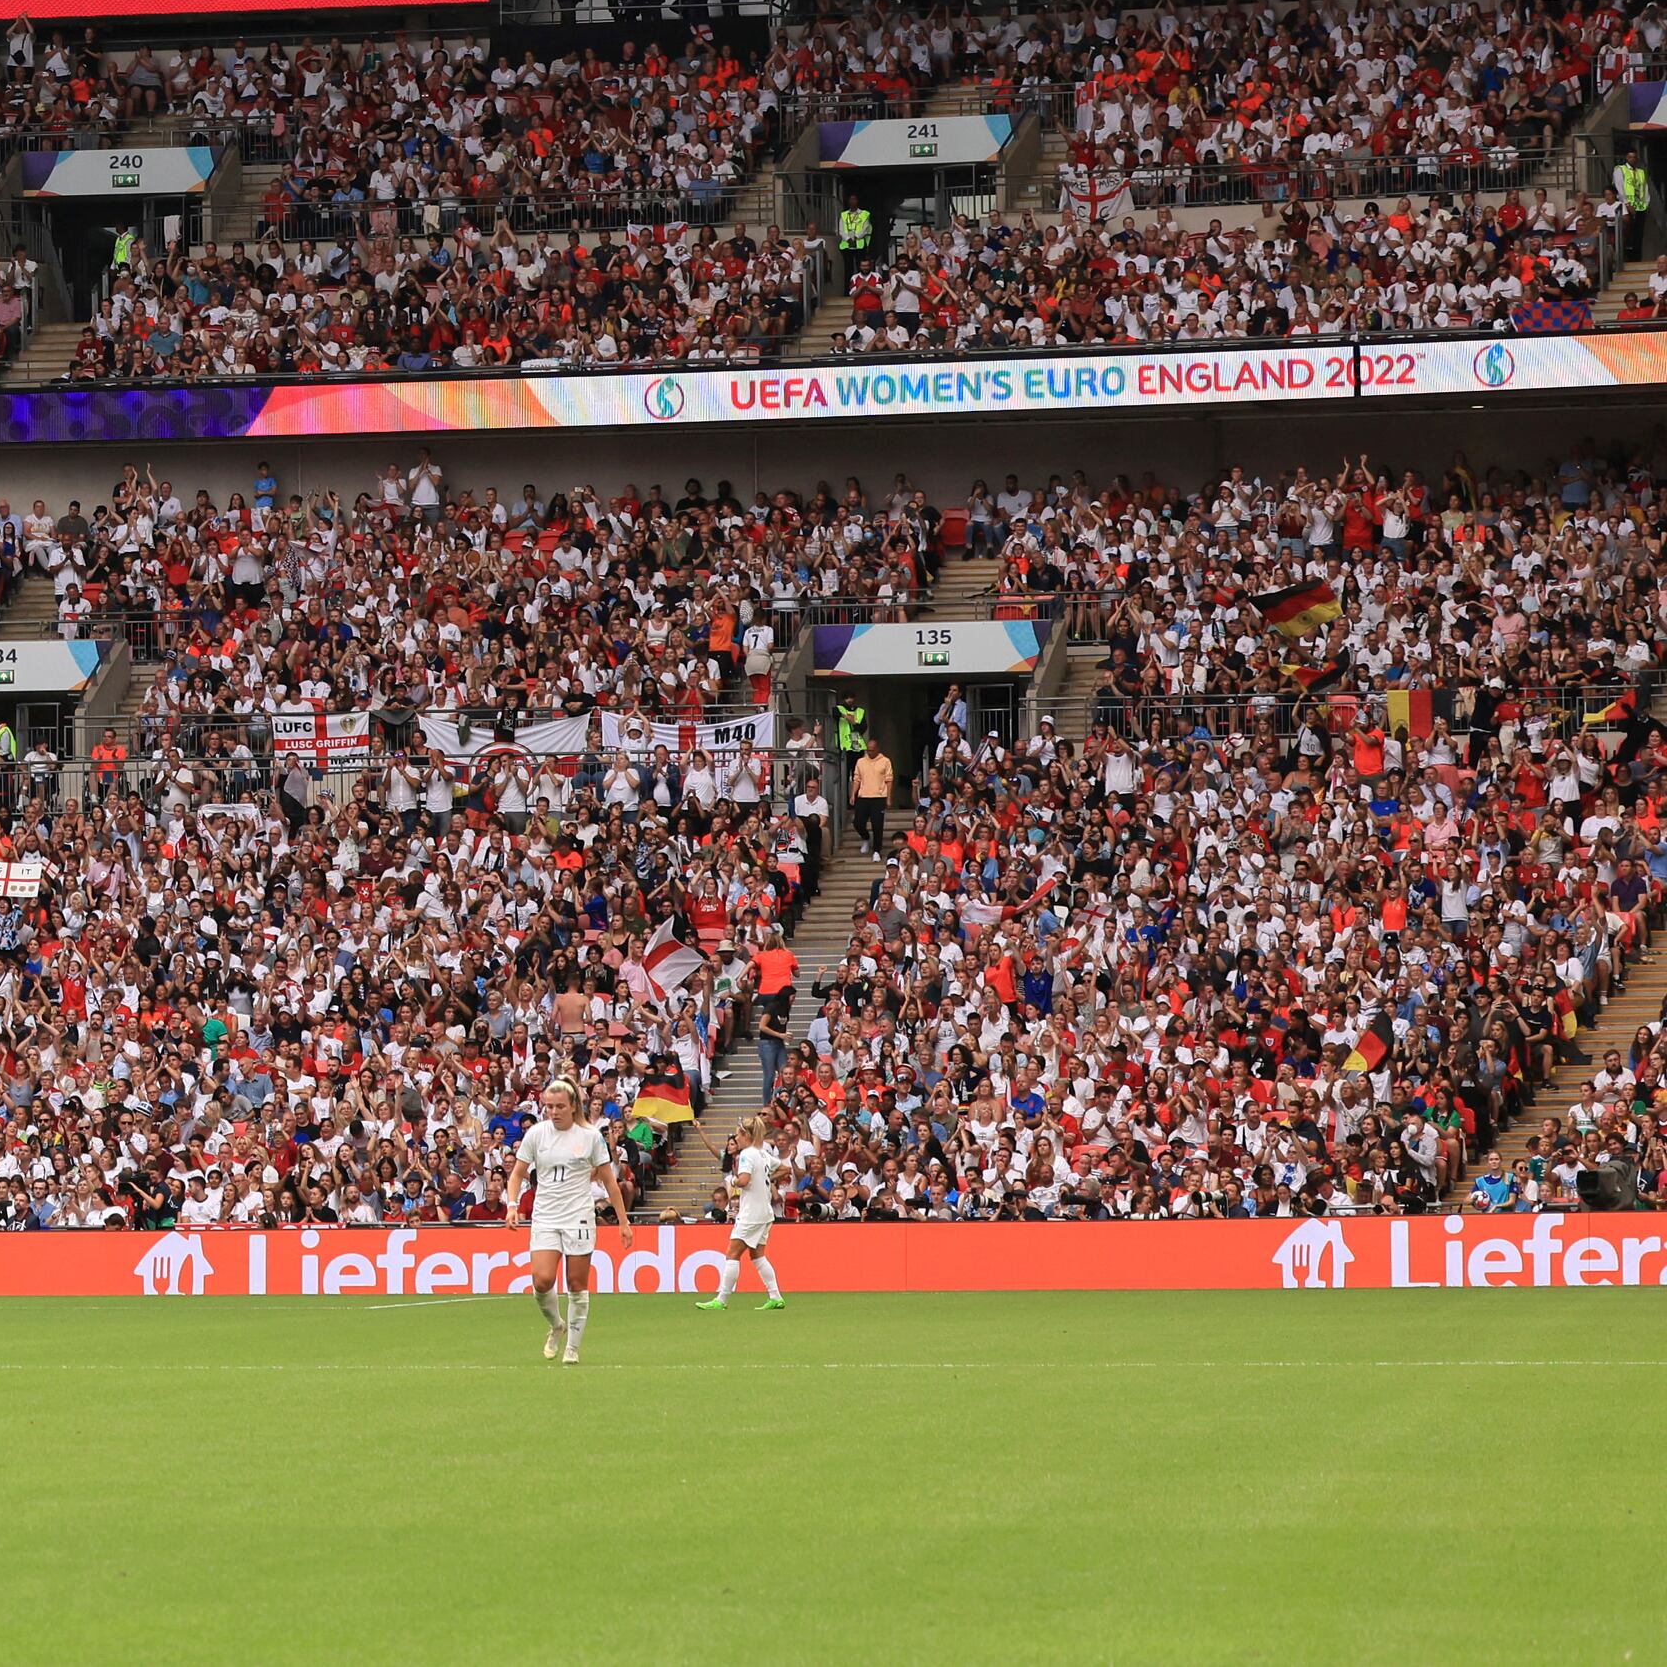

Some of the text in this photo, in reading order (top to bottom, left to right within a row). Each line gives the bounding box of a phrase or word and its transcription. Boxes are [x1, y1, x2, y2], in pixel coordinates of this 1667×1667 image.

[907, 124, 939, 138] 241
[109, 155, 143, 169] 240
[731, 377, 828, 411] UEFA
[837, 370, 1013, 408] WOMEN'S
[1024, 366, 1127, 402] EURO
[1138, 358, 1315, 395] ENGLAND
[752, 634, 759, 649] 7
[916, 629, 952, 645] 135
[274, 721, 313, 733] LUFC
[714, 723, 756, 746] M40
[285, 737, 358, 749] LUSC GRIFFIN
[552, 1166, 566, 1182] 11
[578, 1229, 590, 1240] 11
[249, 1225, 730, 1294] Lieferndo
